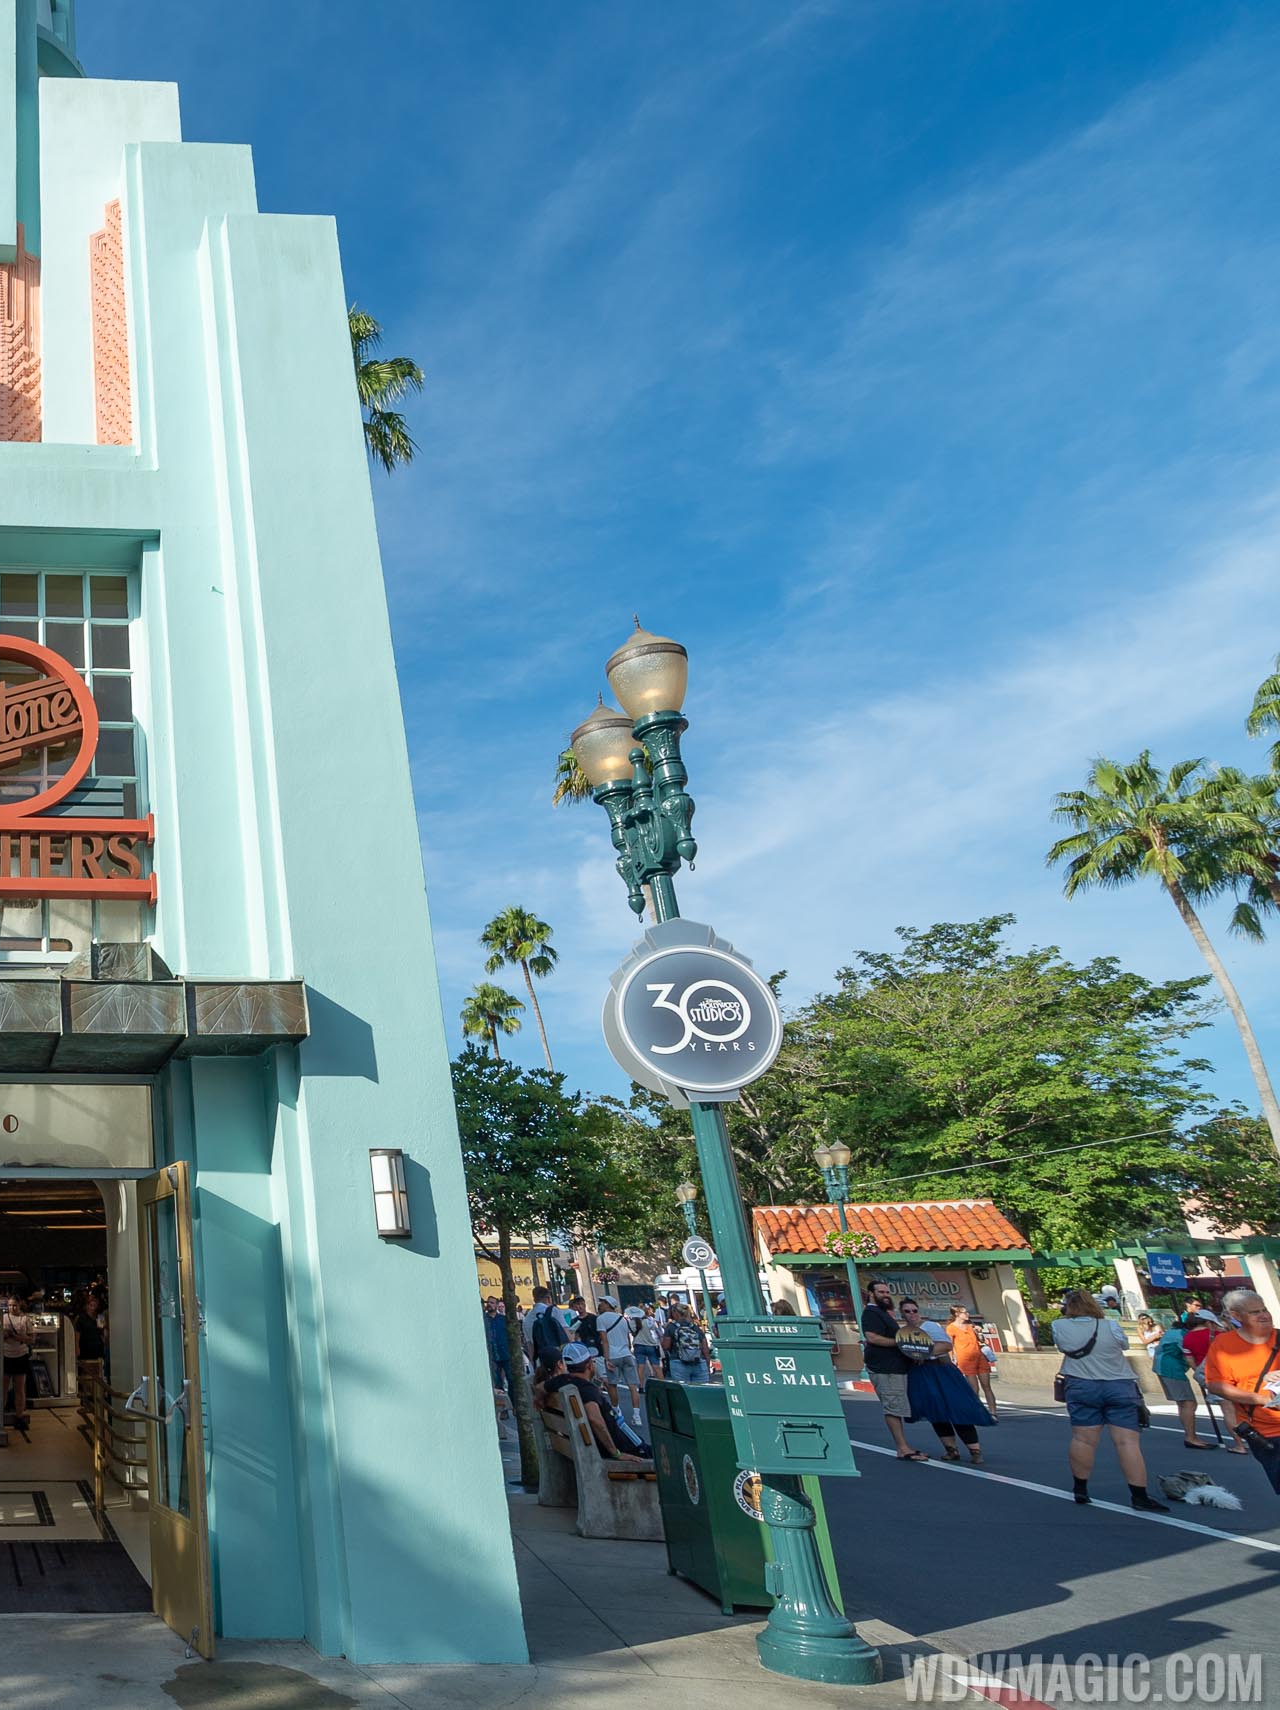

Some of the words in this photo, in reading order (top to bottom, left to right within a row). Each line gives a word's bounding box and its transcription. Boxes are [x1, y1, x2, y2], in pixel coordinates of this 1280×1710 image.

[646, 979, 751, 1055] 30
[690, 1007, 742, 1022] STUDIOS
[688, 1042, 756, 1052] YEARS
[754, 1325, 798, 1334] LETTERS
[745, 1372, 776, 1385] U.S.
[783, 1374, 831, 1386] MAIL
[738, 1497, 752, 1513] OUR
